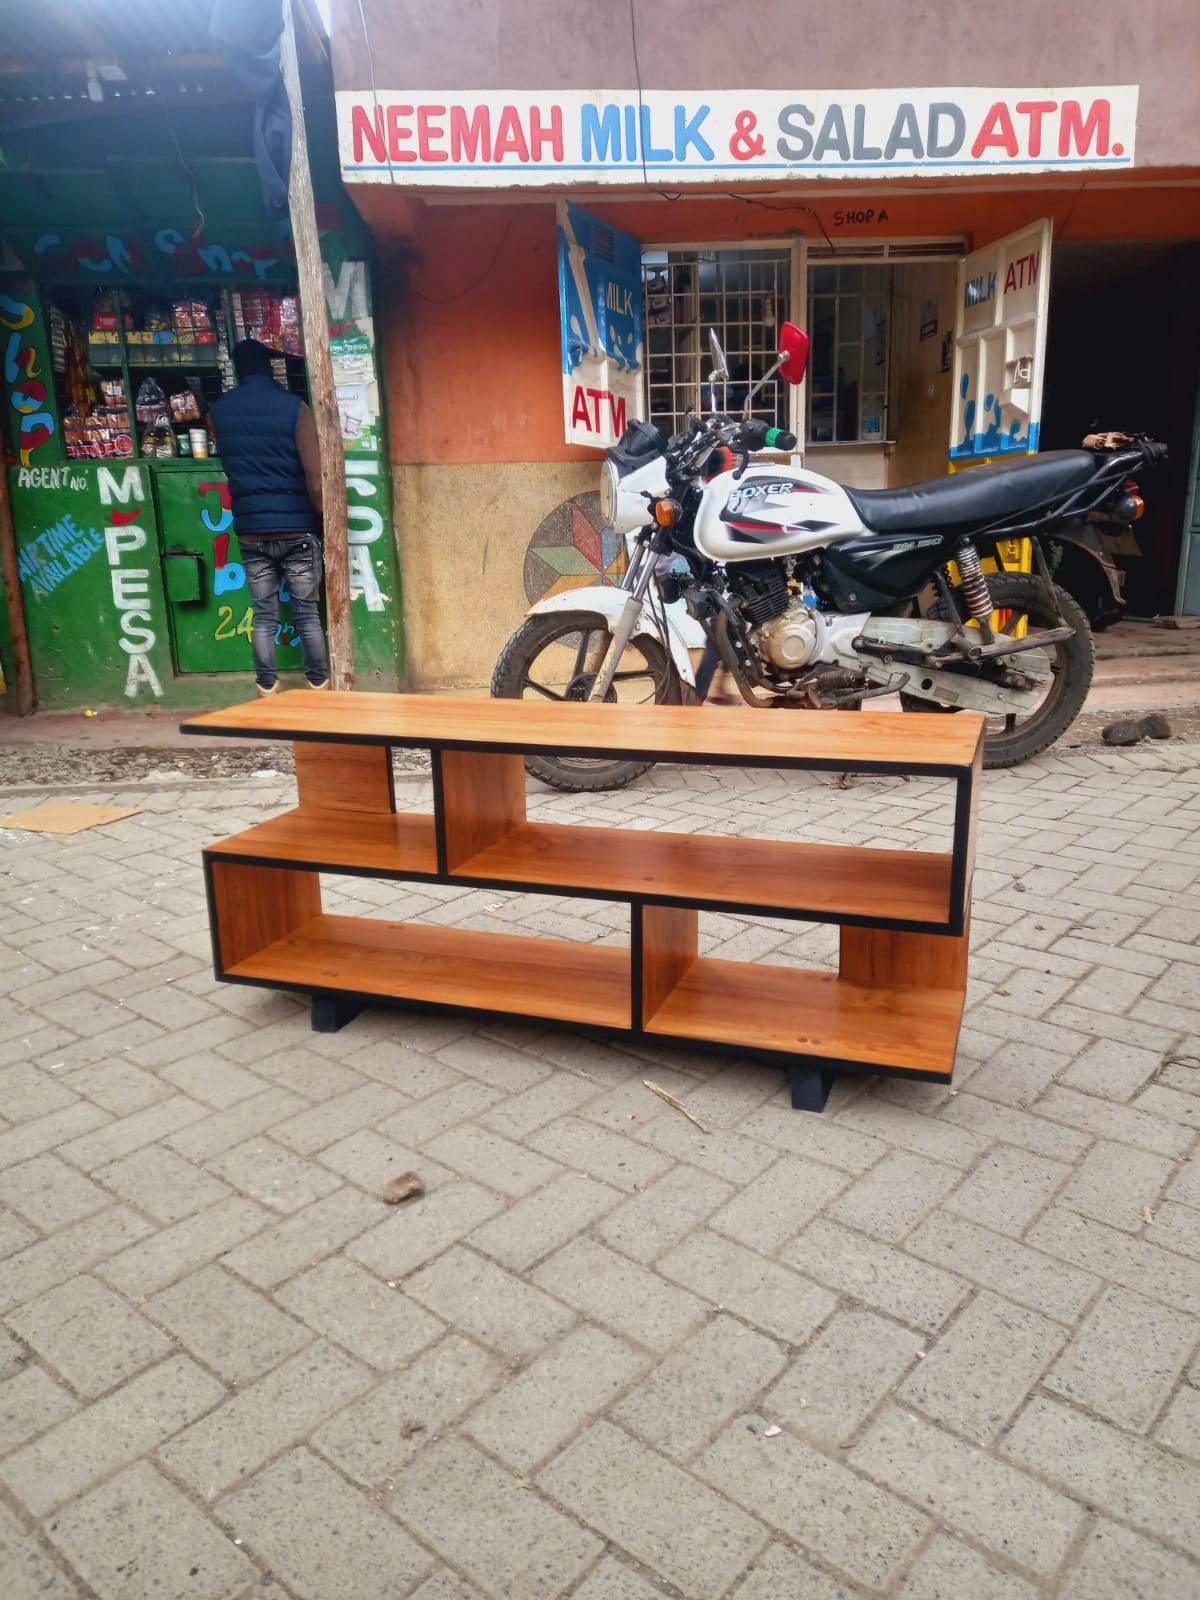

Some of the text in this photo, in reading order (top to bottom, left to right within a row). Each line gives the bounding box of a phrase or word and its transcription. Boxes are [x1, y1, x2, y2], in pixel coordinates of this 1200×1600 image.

[351, 104, 564, 166] NEEMAH
[581, 104, 715, 165] MILK
[728, 109, 767, 162] &
[777, 102, 967, 164] SALAD
[833, 208, 889, 226] SHOP A
[606, 280, 634, 318] MILK
[965, 250, 1041, 310] MILK ATM
[572, 385, 627, 439] ATM
[18, 466, 71, 489] AGENT
[729, 482, 794, 501] BOXER
